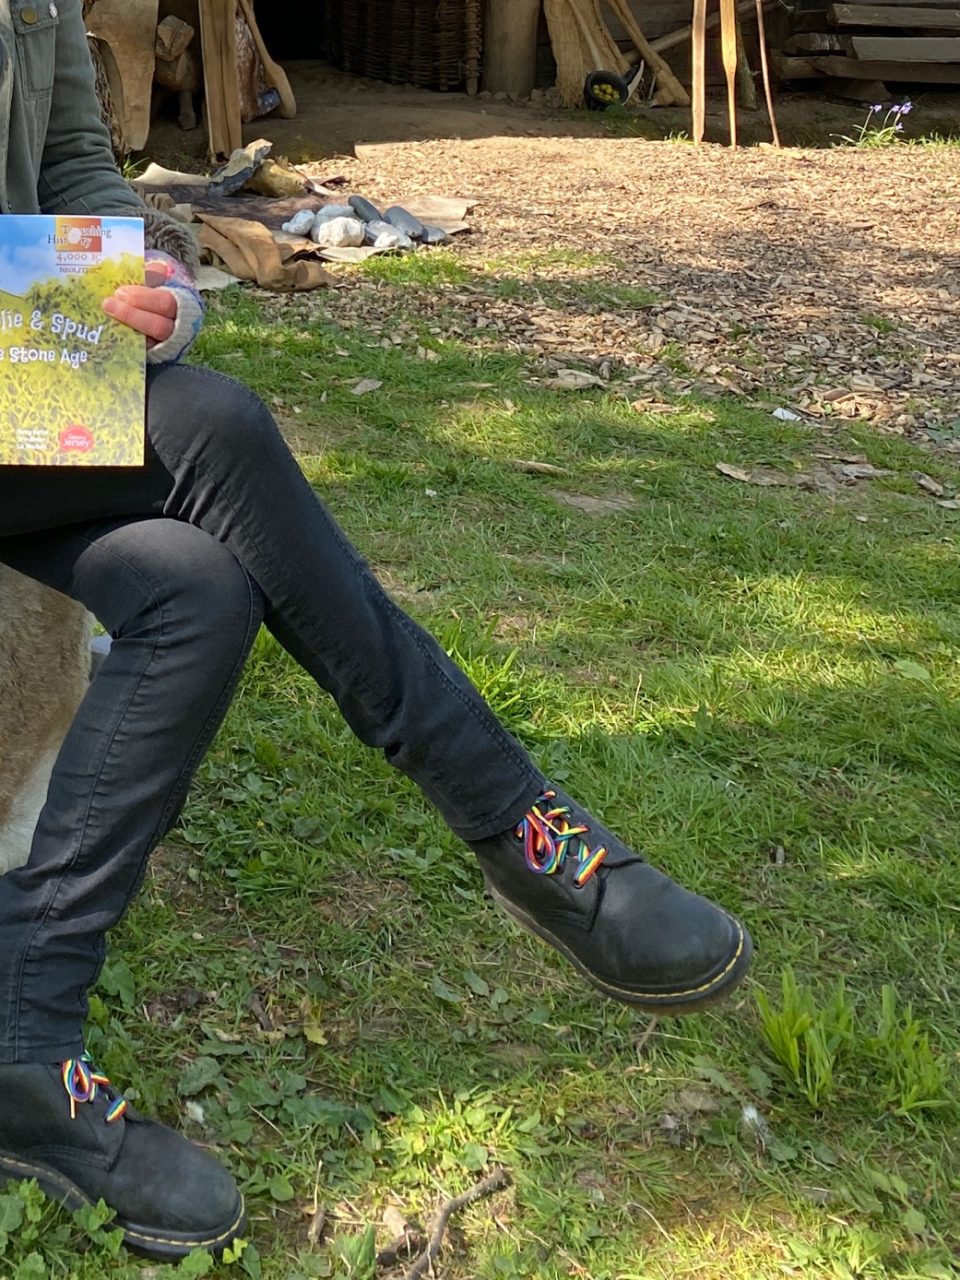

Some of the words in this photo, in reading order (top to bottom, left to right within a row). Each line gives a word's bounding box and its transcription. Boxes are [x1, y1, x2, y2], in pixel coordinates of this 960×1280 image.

[30, 309, 45, 331] &
[51, 313, 103, 344] Spud
[9, 346, 56, 363] Stone
[60, 348, 89, 369] Age
